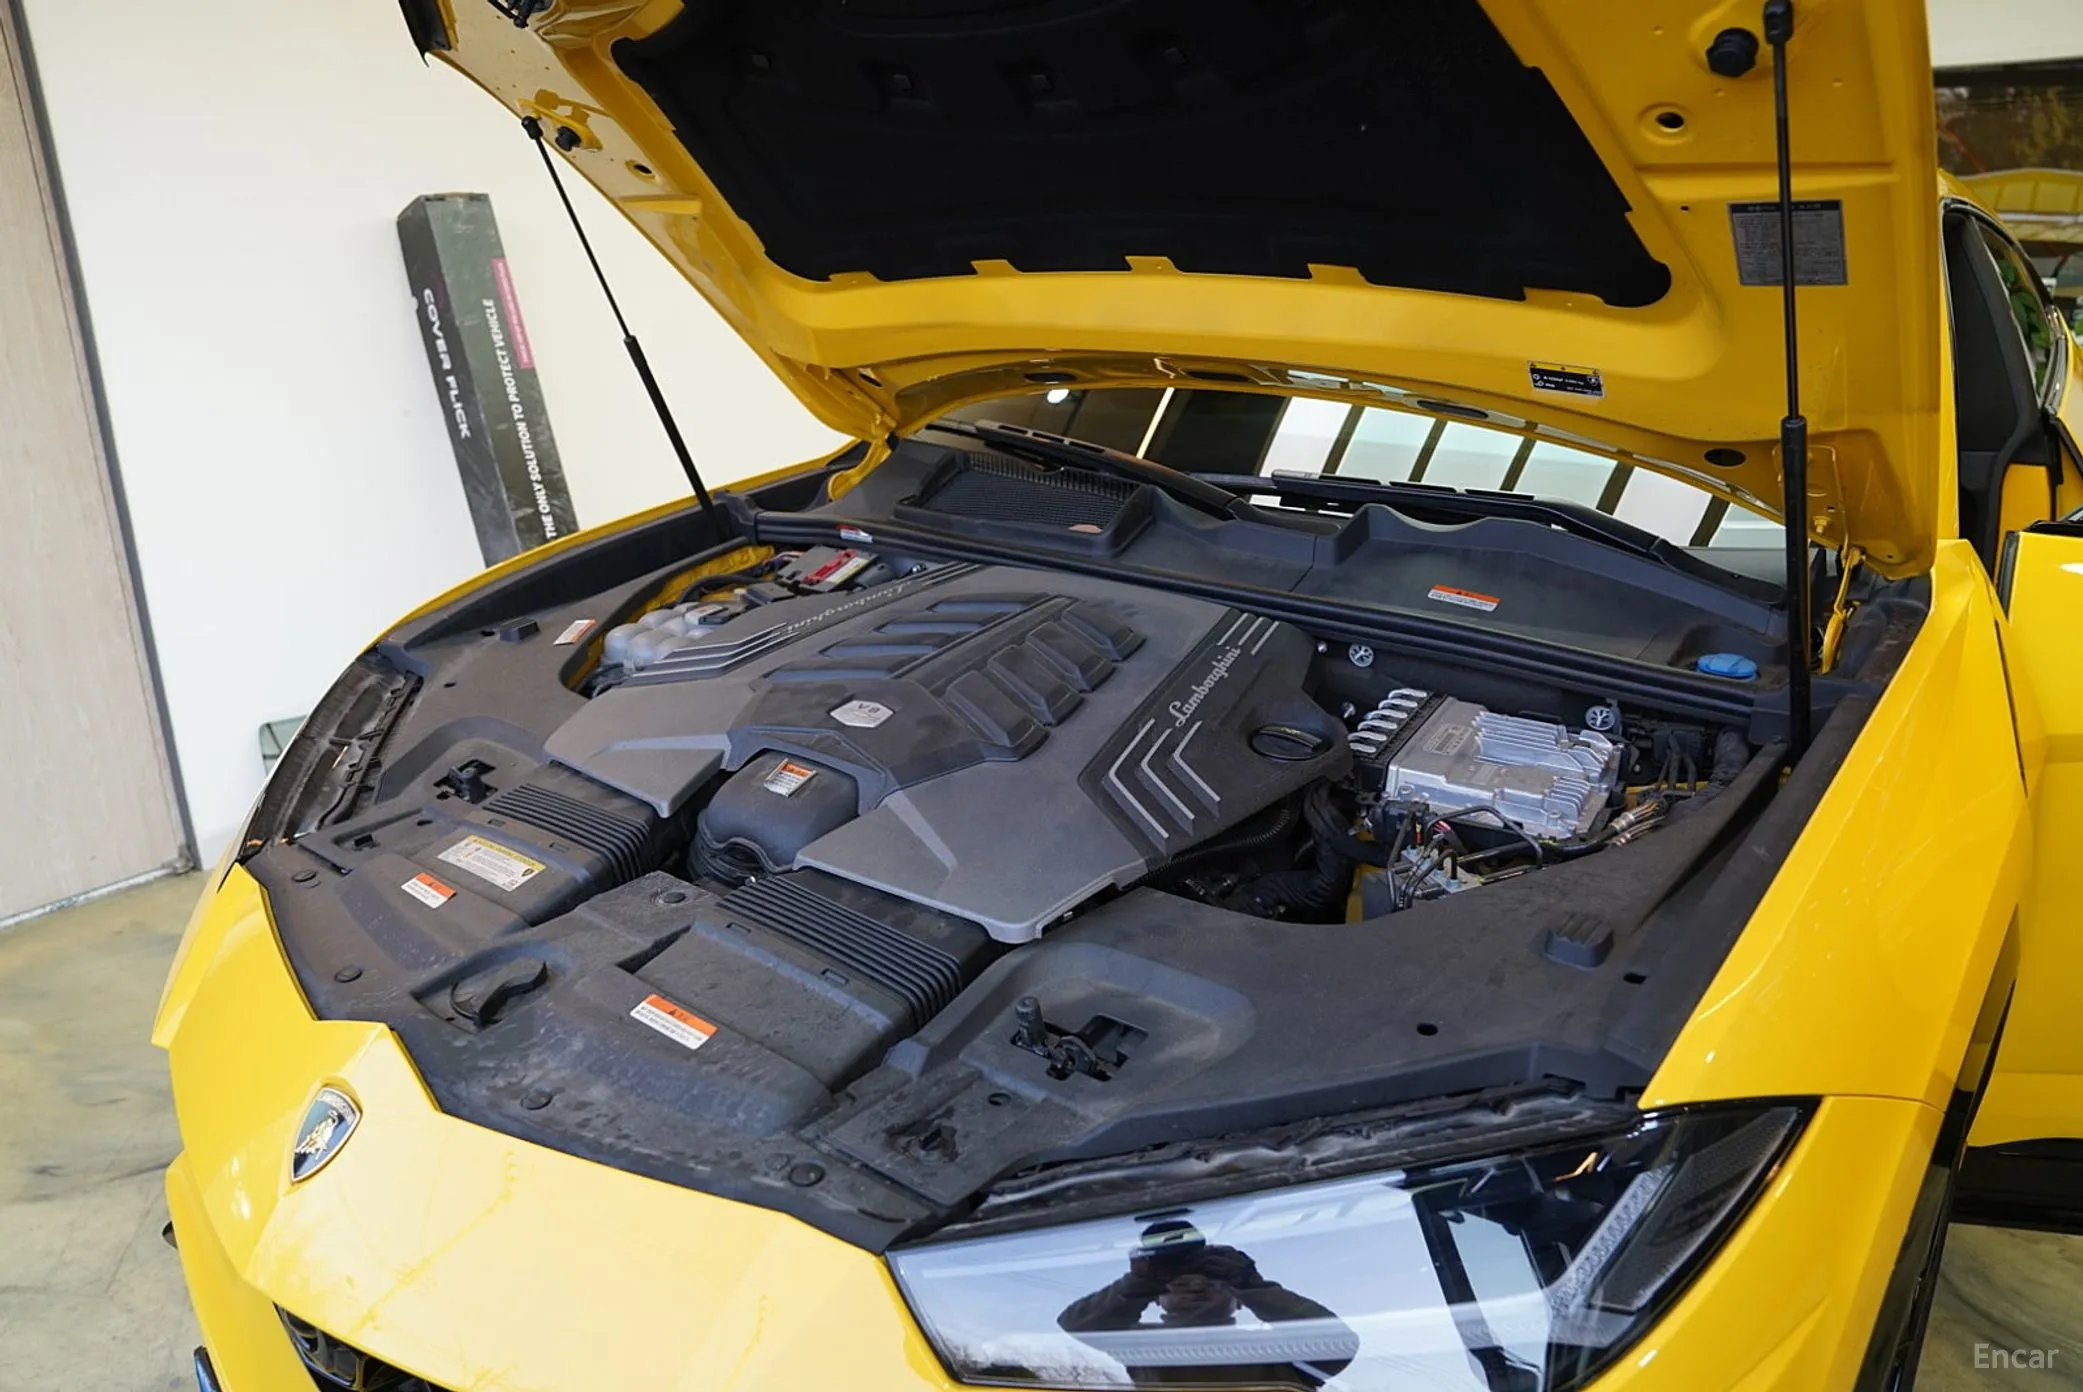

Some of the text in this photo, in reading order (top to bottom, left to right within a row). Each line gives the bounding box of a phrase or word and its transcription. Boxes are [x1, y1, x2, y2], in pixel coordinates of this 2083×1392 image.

[482, 298, 505, 347] VEHICLE
[423, 287, 471, 439] COVER FLICK
[496, 349, 520, 402] PROTECT
[511, 403, 525, 420] TO
[516, 422, 541, 481] SOLUTION
[532, 482, 550, 513] ONLY
[541, 514, 557, 539] THE
[1168, 645, 1242, 727] Lamborghini
